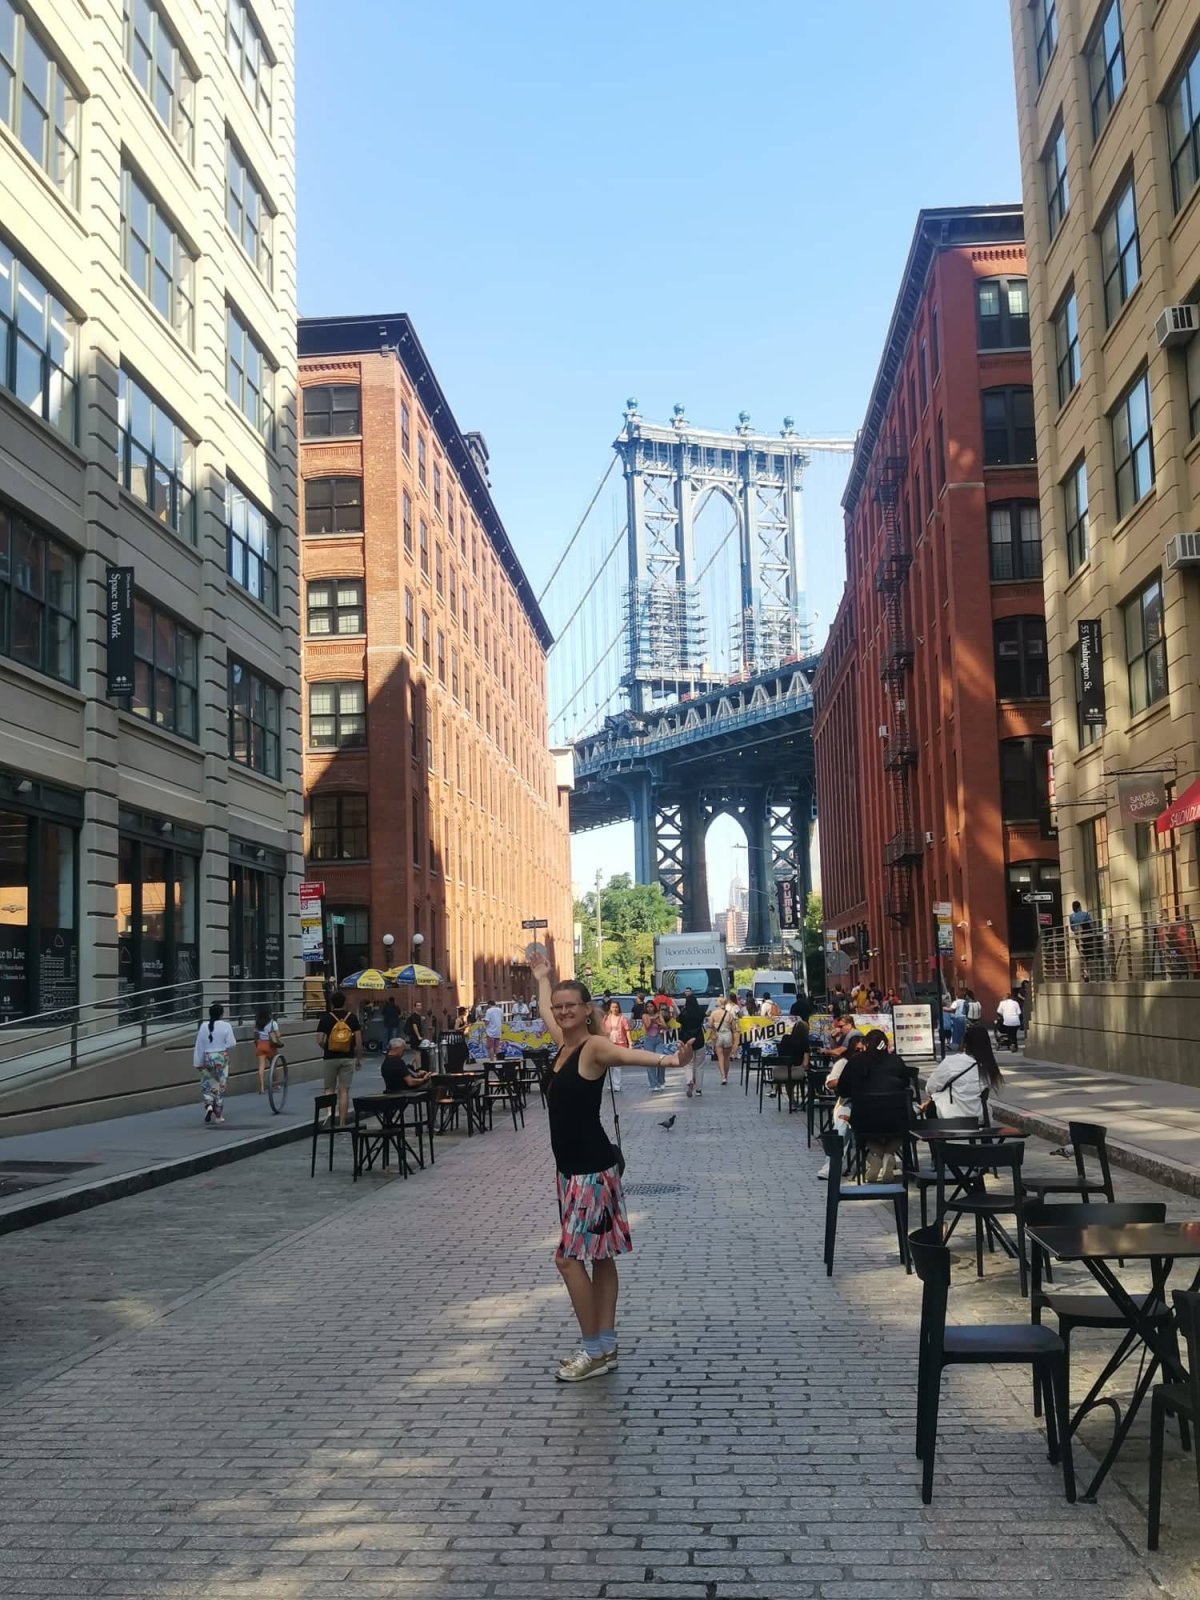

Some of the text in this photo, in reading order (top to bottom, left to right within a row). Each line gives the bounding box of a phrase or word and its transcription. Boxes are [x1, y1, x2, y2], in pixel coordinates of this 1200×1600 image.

[109, 573, 121, 639] Space to Work
[1080, 624, 1092, 692] 55 Washington St.
[1129, 791, 1155, 804] SALON
[1130, 797, 1159, 811] DUMBO
[1169, 808, 1189, 828] SALON
[783, 882, 793, 924] DUMBO
[665, 945, 716, 956] Room&Board
